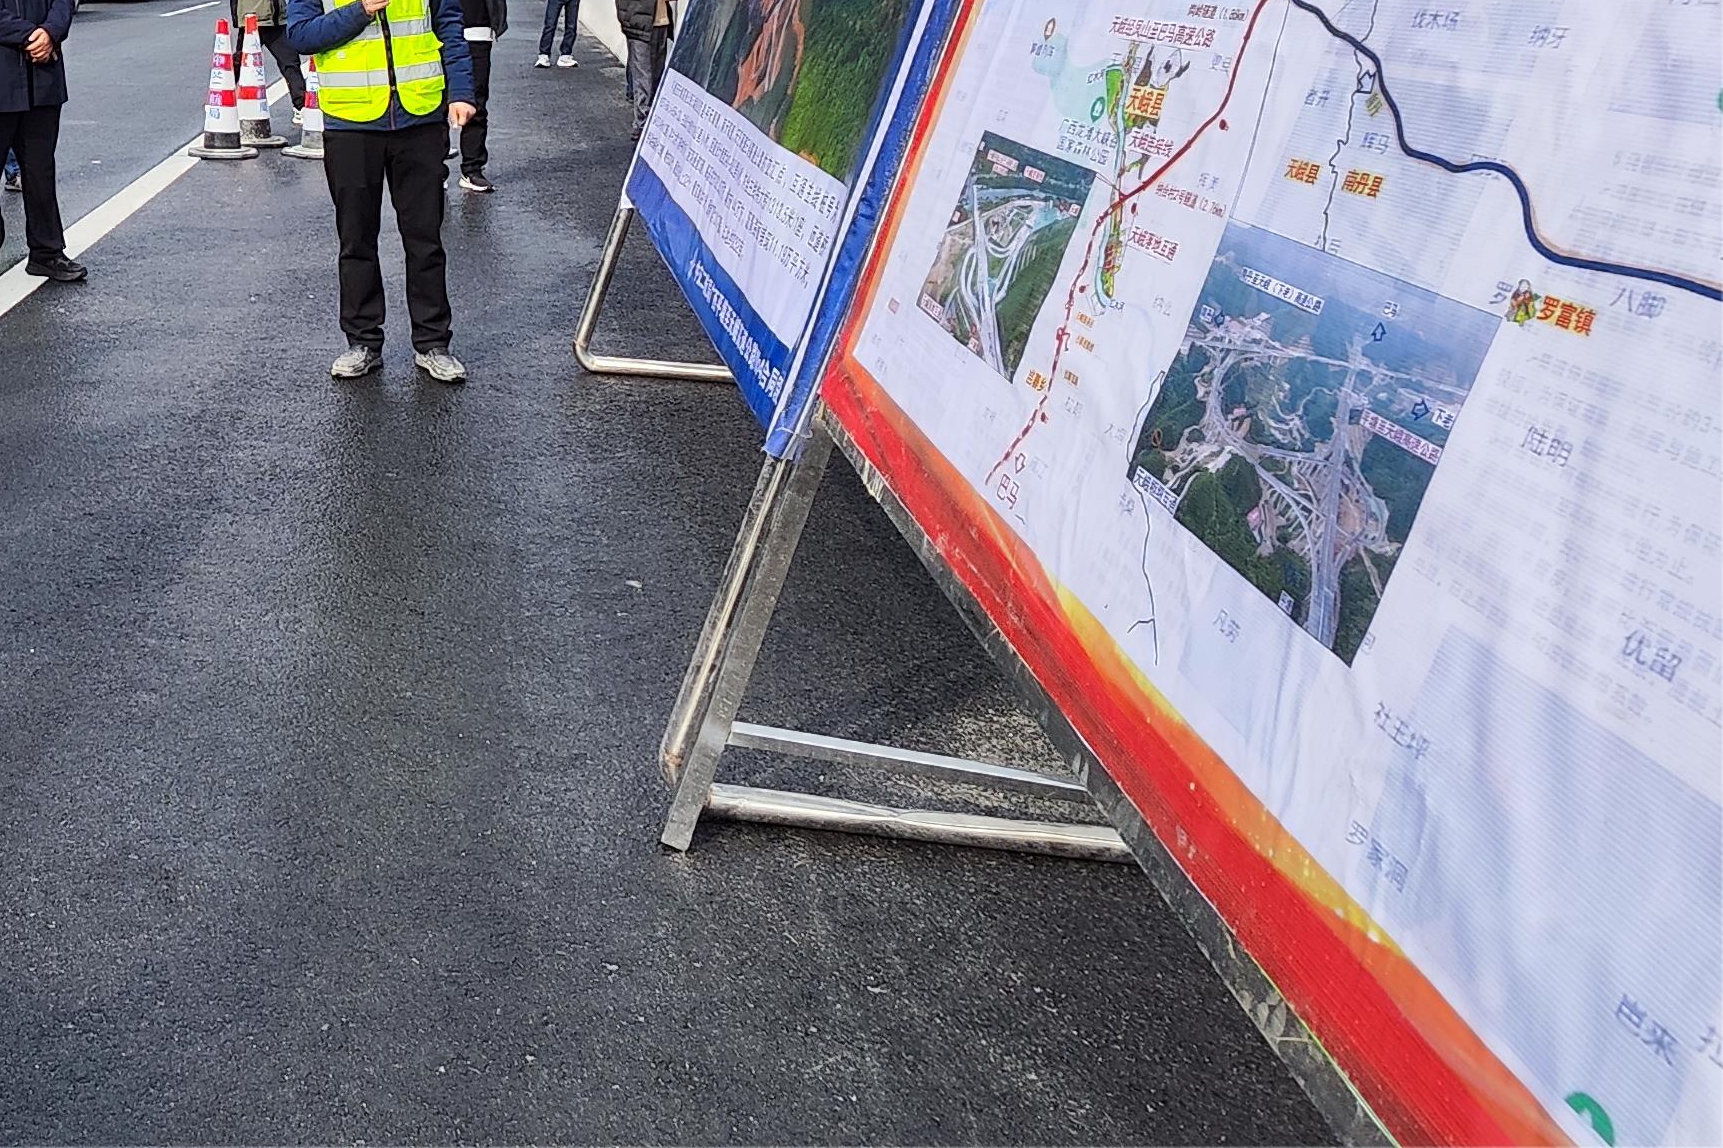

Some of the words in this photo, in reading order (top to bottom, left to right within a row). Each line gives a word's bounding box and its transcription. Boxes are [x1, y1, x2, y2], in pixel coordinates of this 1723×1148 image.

[1126, 88, 1165, 116] 天峨县
[1284, 158, 1321, 185] 天峨县
[1341, 169, 1384, 199] 南丹县
[1537, 294, 1597, 337] 罗富镇
